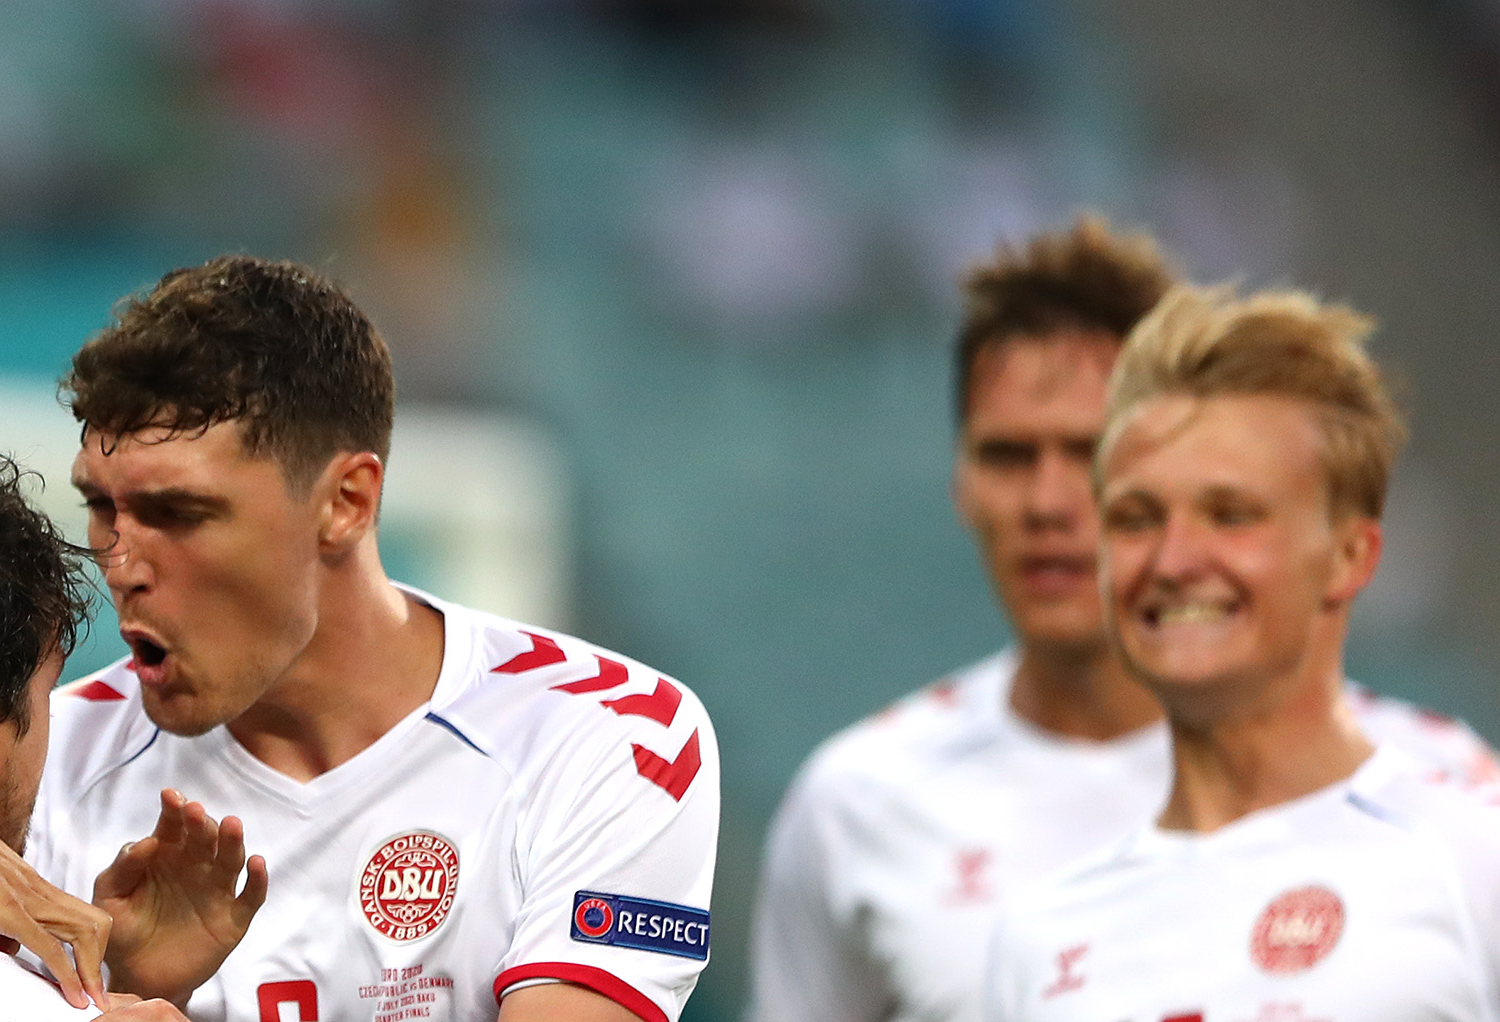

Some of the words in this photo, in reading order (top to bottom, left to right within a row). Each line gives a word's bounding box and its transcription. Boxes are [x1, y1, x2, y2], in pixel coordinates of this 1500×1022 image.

[361, 861, 384, 927] DANSK
[379, 867, 444, 902] DBU
[583, 900, 607, 912] UEFA
[385, 924, 428, 940] 1889
[617, 910, 709, 946] RESPECT
[405, 1007, 430, 1019] FINALS
